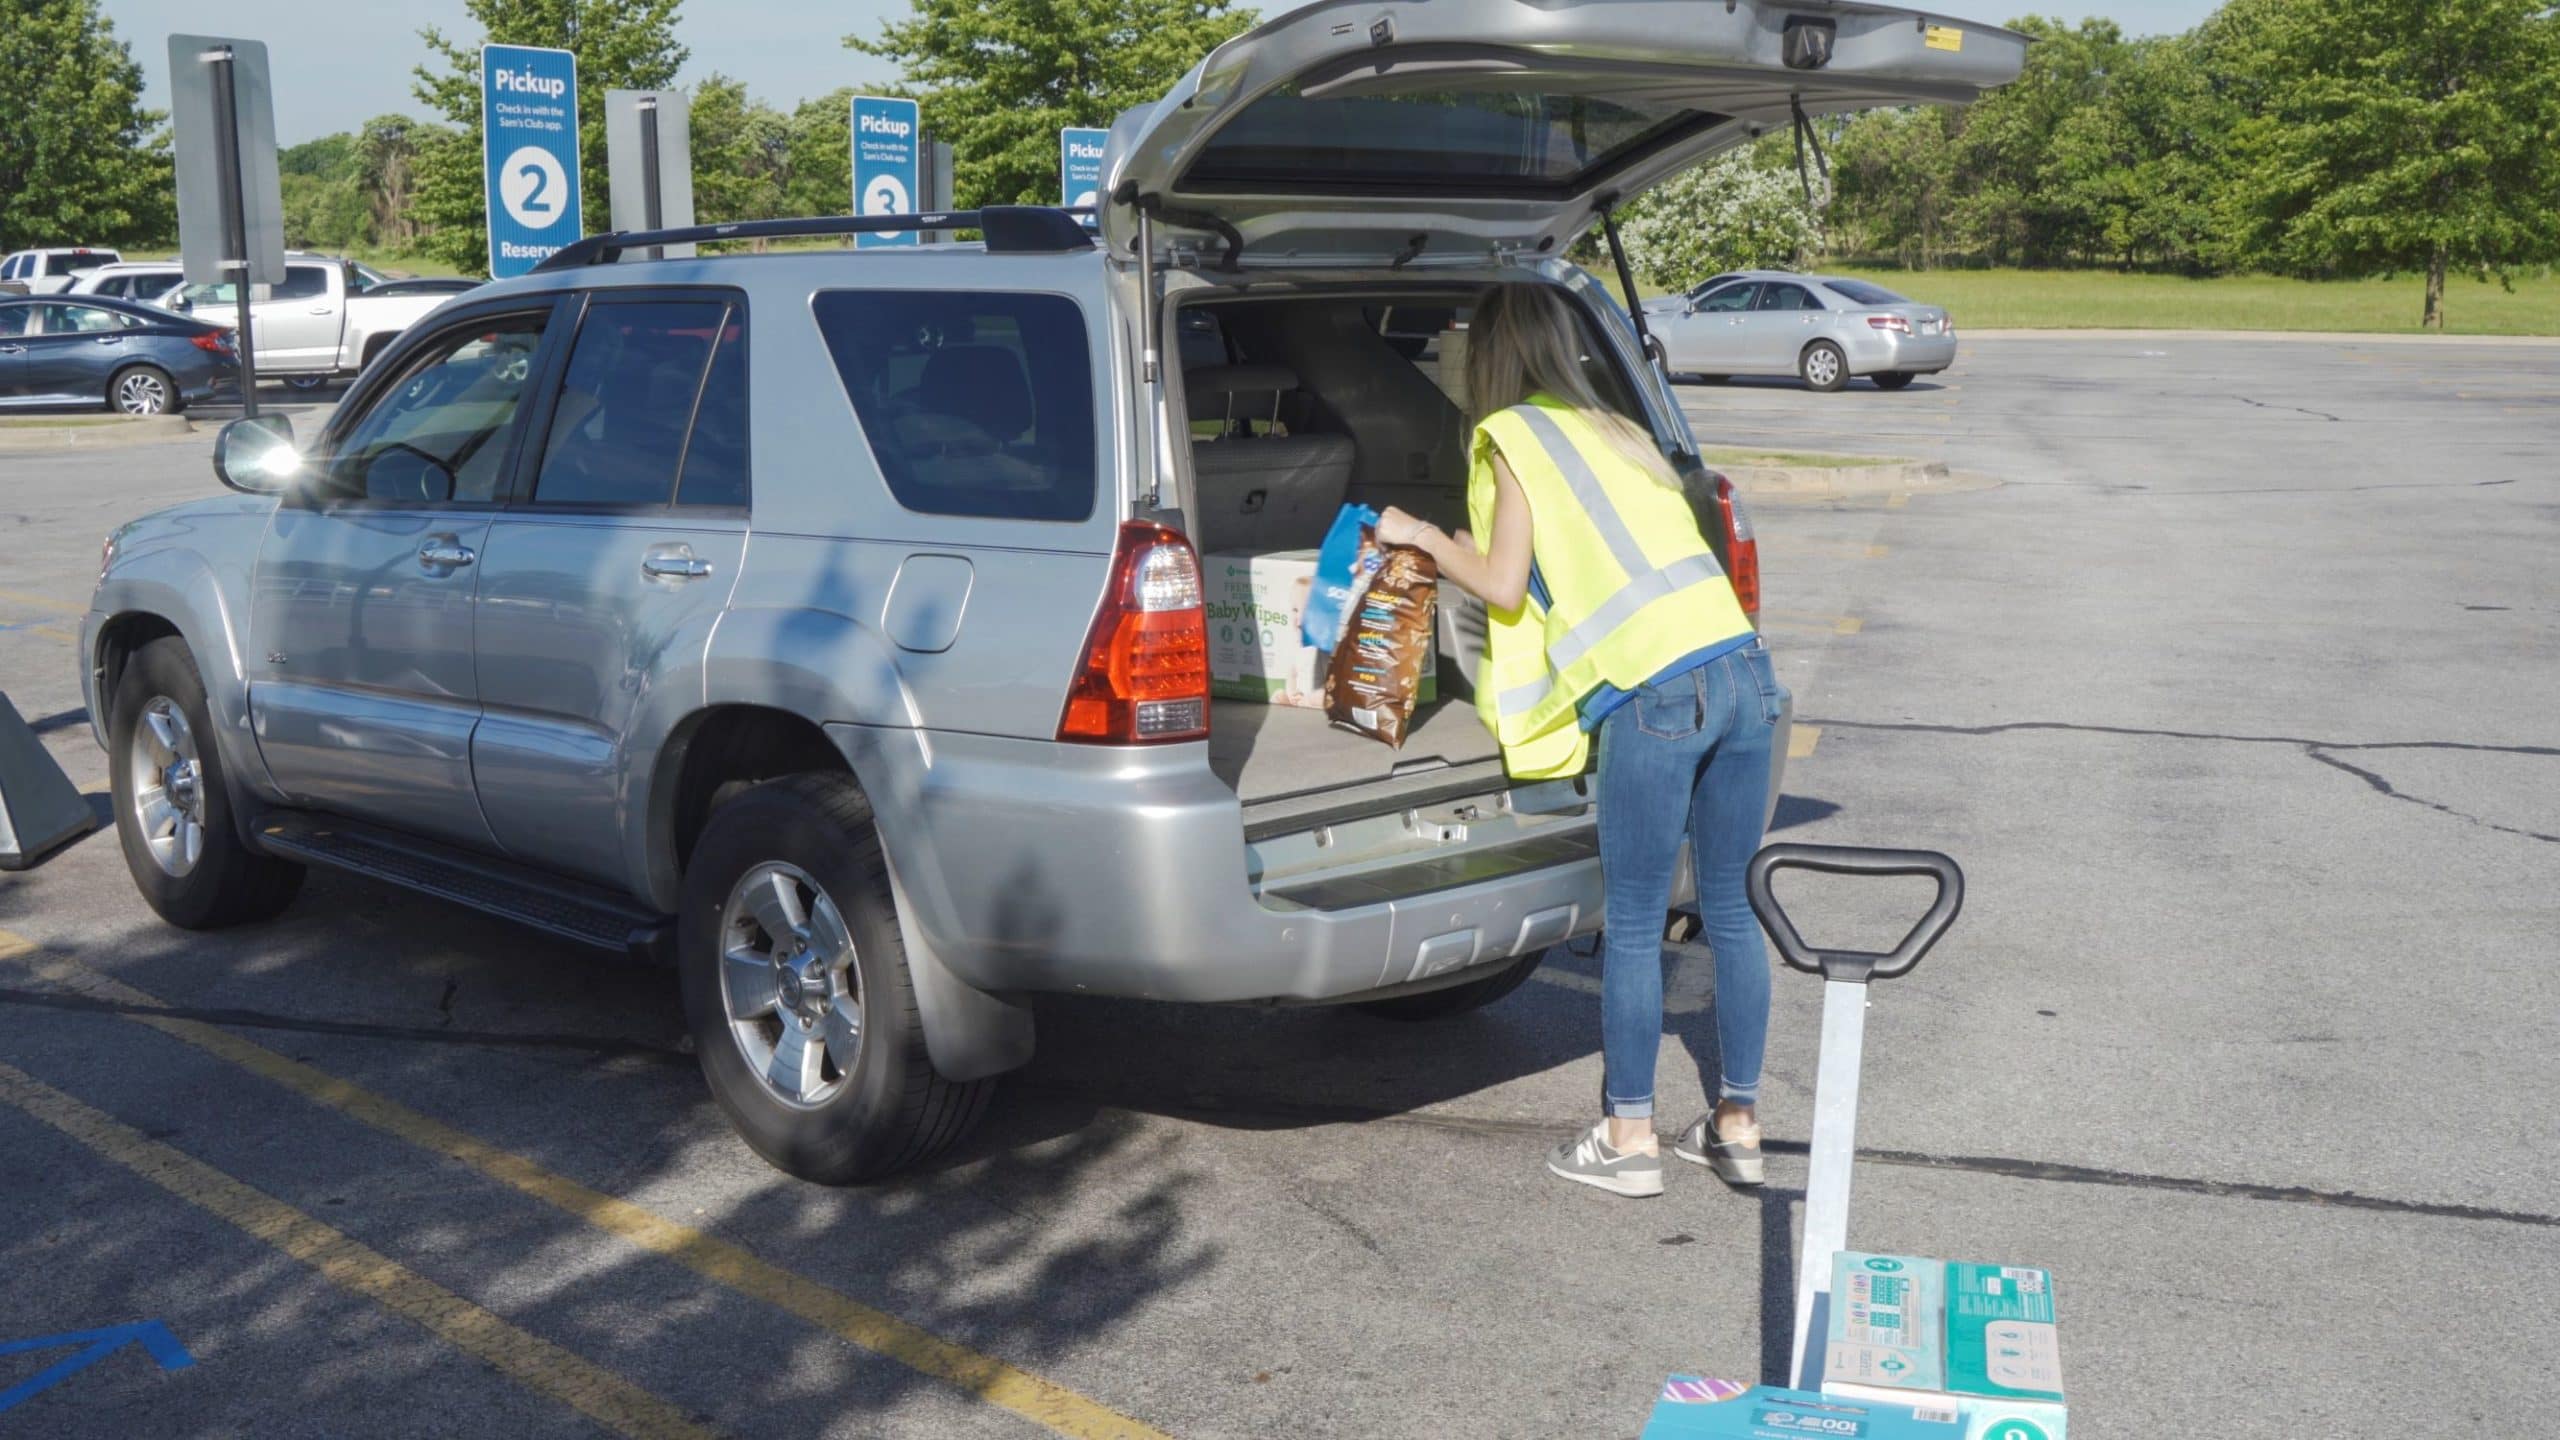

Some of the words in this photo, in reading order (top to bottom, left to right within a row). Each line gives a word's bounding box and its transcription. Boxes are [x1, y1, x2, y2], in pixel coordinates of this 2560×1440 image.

[495, 69, 565, 98] Pickup
[496, 103, 521, 114] Check
[524, 104, 531, 114] in
[532, 105, 549, 115] with
[550, 106, 564, 116] the
[499, 117, 524, 129] Sam's
[525, 118, 543, 130] Club
[860, 115, 910, 138] Pickup
[1069, 143, 1103, 158] Picku
[519, 164, 550, 212] 2
[877, 188, 896, 214] 3
[1207, 600, 1240, 622] Baby
[1242, 602, 1289, 626] Wipes
[1822, 1418, 1858, 1432] 100
